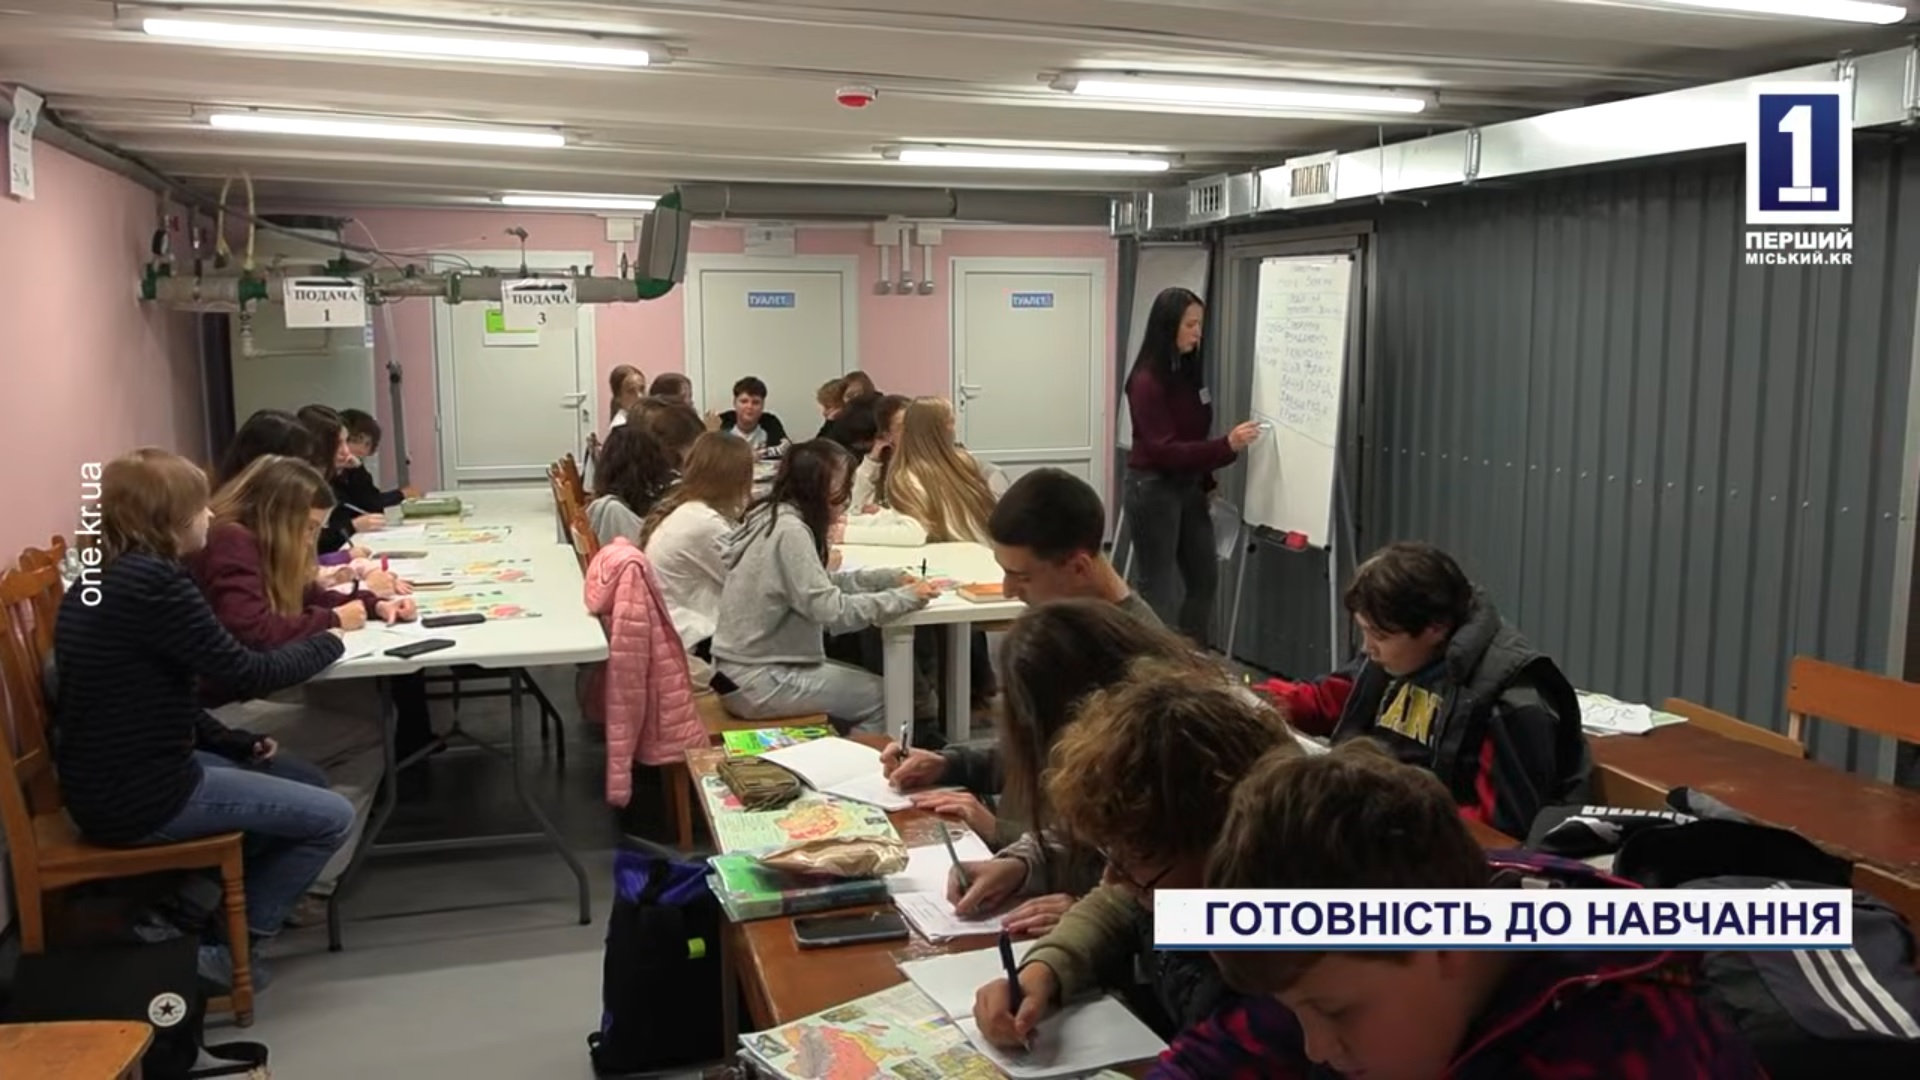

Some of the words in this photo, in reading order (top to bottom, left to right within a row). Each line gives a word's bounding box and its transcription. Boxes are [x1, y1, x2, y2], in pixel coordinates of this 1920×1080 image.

[295, 289, 357, 302] ПОДАЧА
[512, 294, 570, 305] ПОДАЧА
[324, 309, 330, 322] 1
[537, 311, 547, 325] 3
